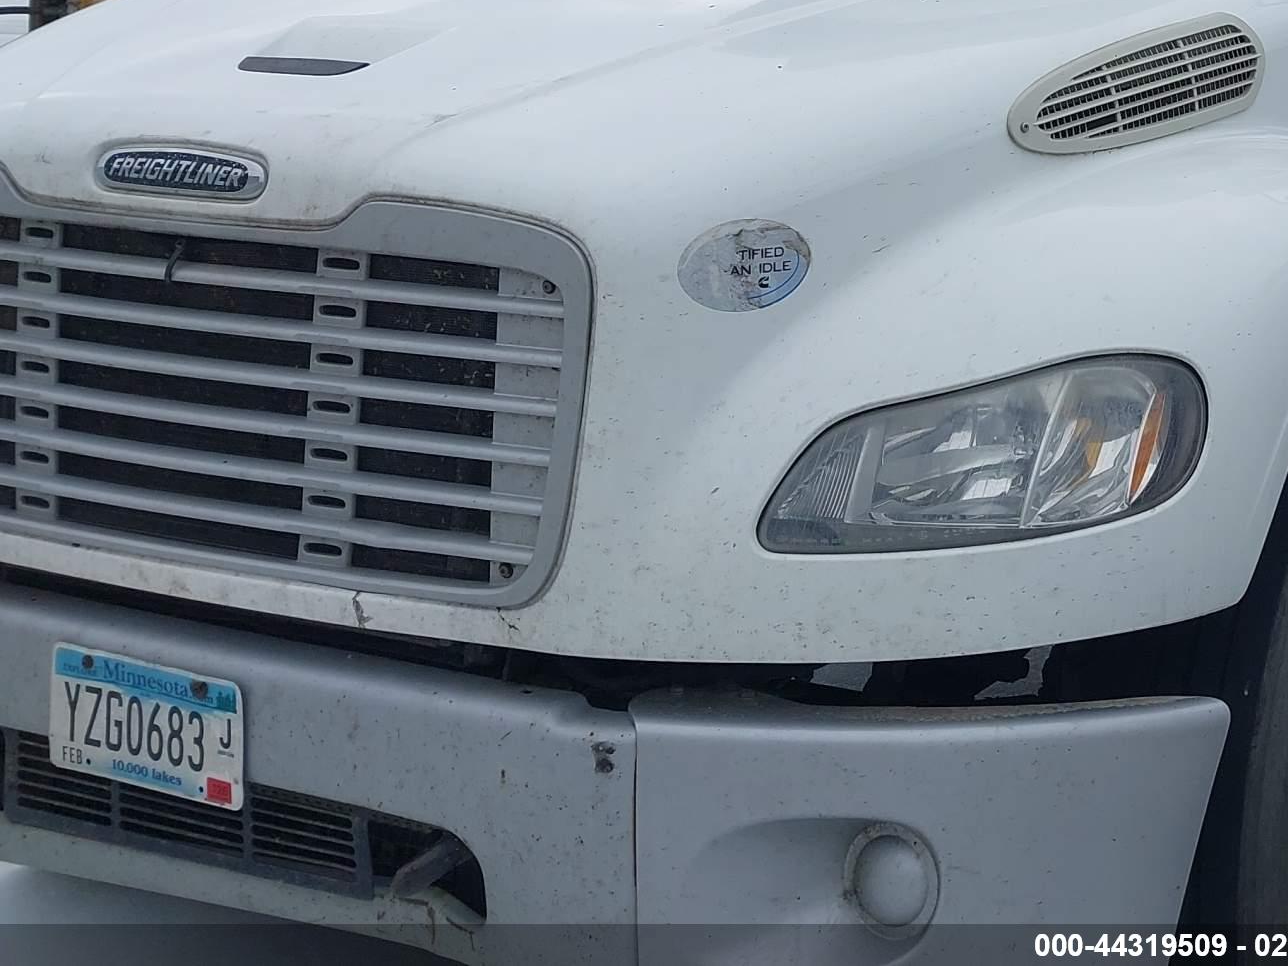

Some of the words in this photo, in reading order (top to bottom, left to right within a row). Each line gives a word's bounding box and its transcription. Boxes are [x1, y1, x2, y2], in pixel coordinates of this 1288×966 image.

[108, 157, 242, 188] FREIGHTLINER
[759, 261, 792, 274] IDLE
[64, 681, 205, 772] YZG0683
[219, 718, 231, 749] J
[62, 745, 83, 765] FEB
[152, 768, 182, 786] lakes
